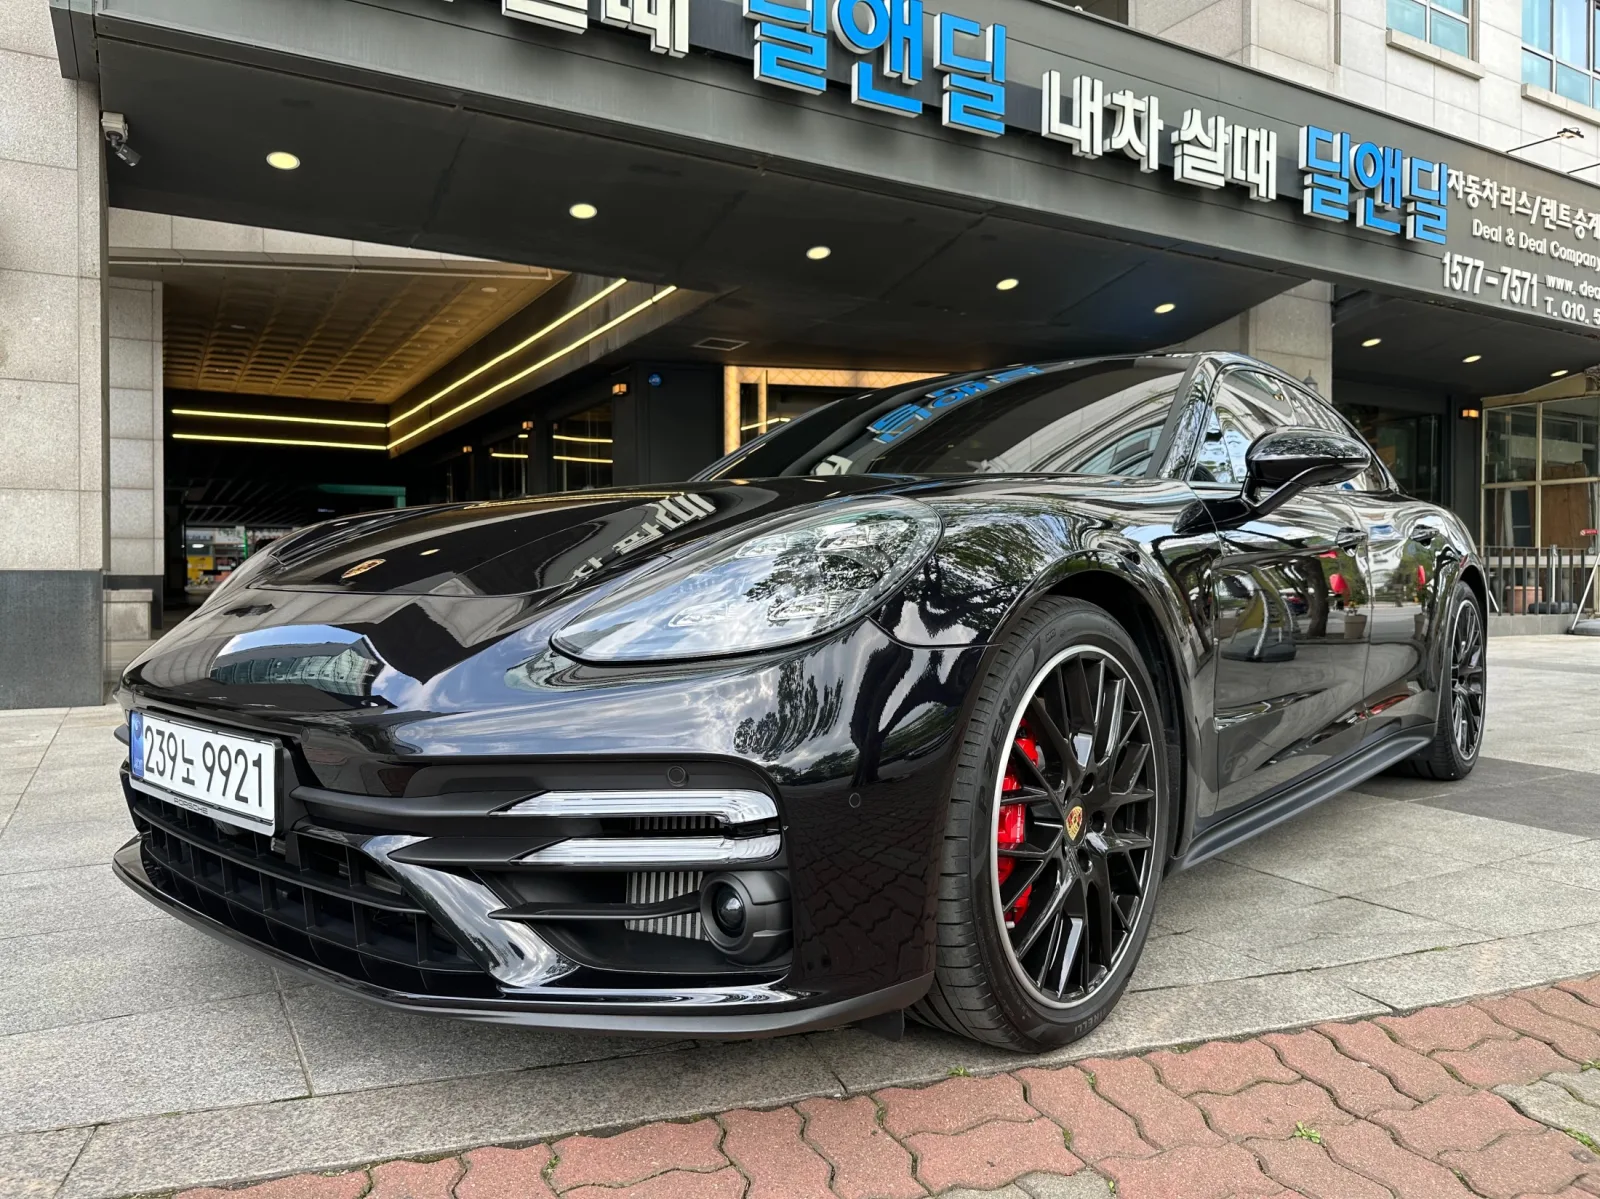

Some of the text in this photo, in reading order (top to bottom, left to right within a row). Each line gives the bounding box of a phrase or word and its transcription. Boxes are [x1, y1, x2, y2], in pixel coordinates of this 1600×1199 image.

[743, 0, 1006, 138] 딜앤딜
[1042, 69, 1164, 173] 내차
[1171, 108, 1277, 202] 살때
[1298, 125, 1449, 245] 딜앤딜
[1472, 218, 1600, 272] Deal & Deal Company
[1442, 252, 1538, 307] 1577-7571
[173, 797, 209, 815] PORSCHE
